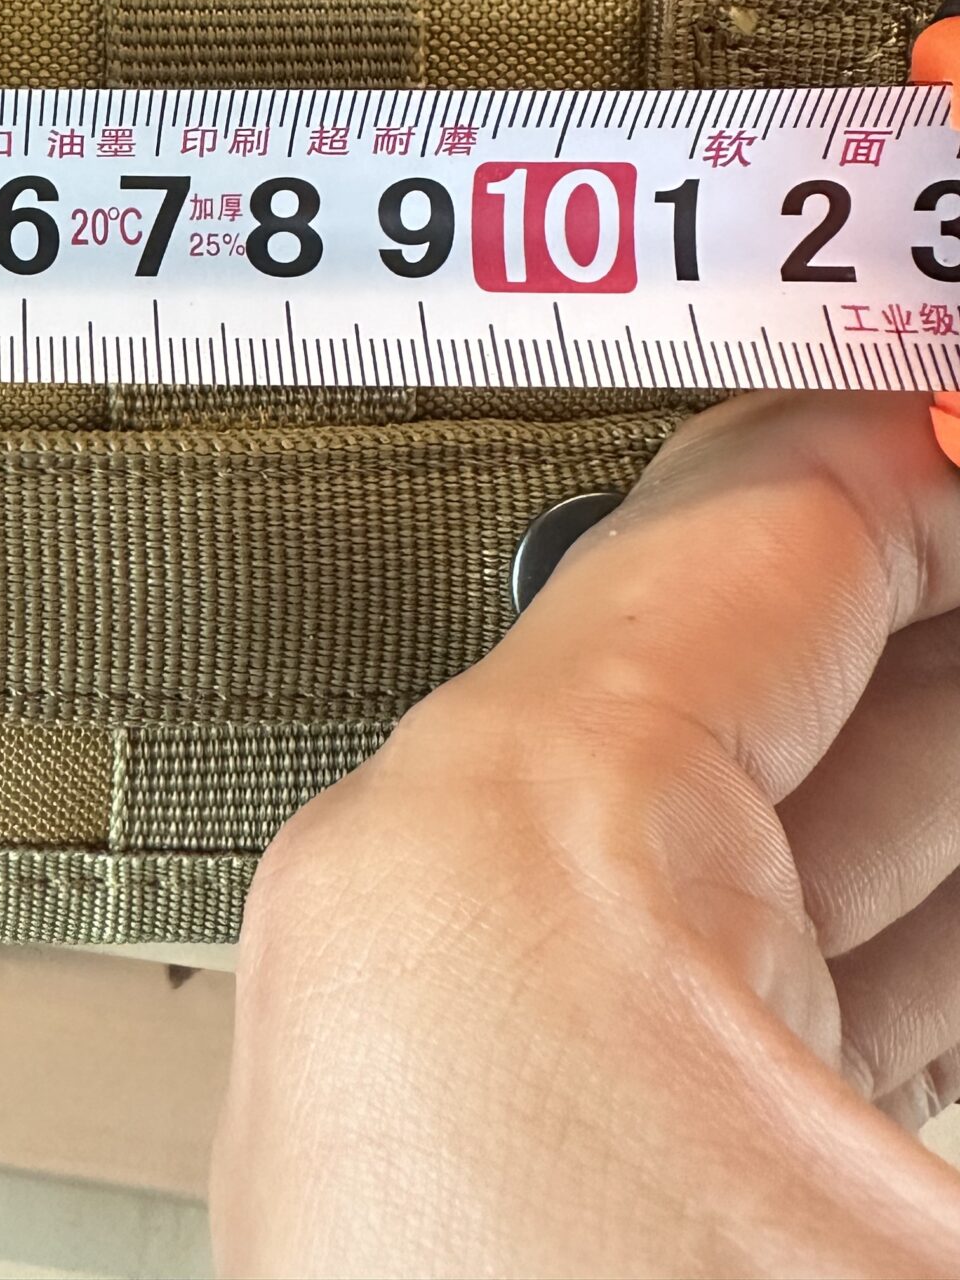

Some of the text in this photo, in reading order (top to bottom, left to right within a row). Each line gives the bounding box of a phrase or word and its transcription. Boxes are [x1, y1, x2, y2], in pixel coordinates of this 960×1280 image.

[189, 193, 243, 222] 加厚
[120, 175, 191, 277] 7
[245, 177, 324, 278] 8
[377, 177, 455, 279] 9
[487, 168, 620, 283] 10
[654, 178, 700, 282] 1
[780, 179, 857, 283] 2
[910, 179, 960, 283] 3
[189, 232, 246, 257] 25%
[841, 303, 959, 336] 工业级
